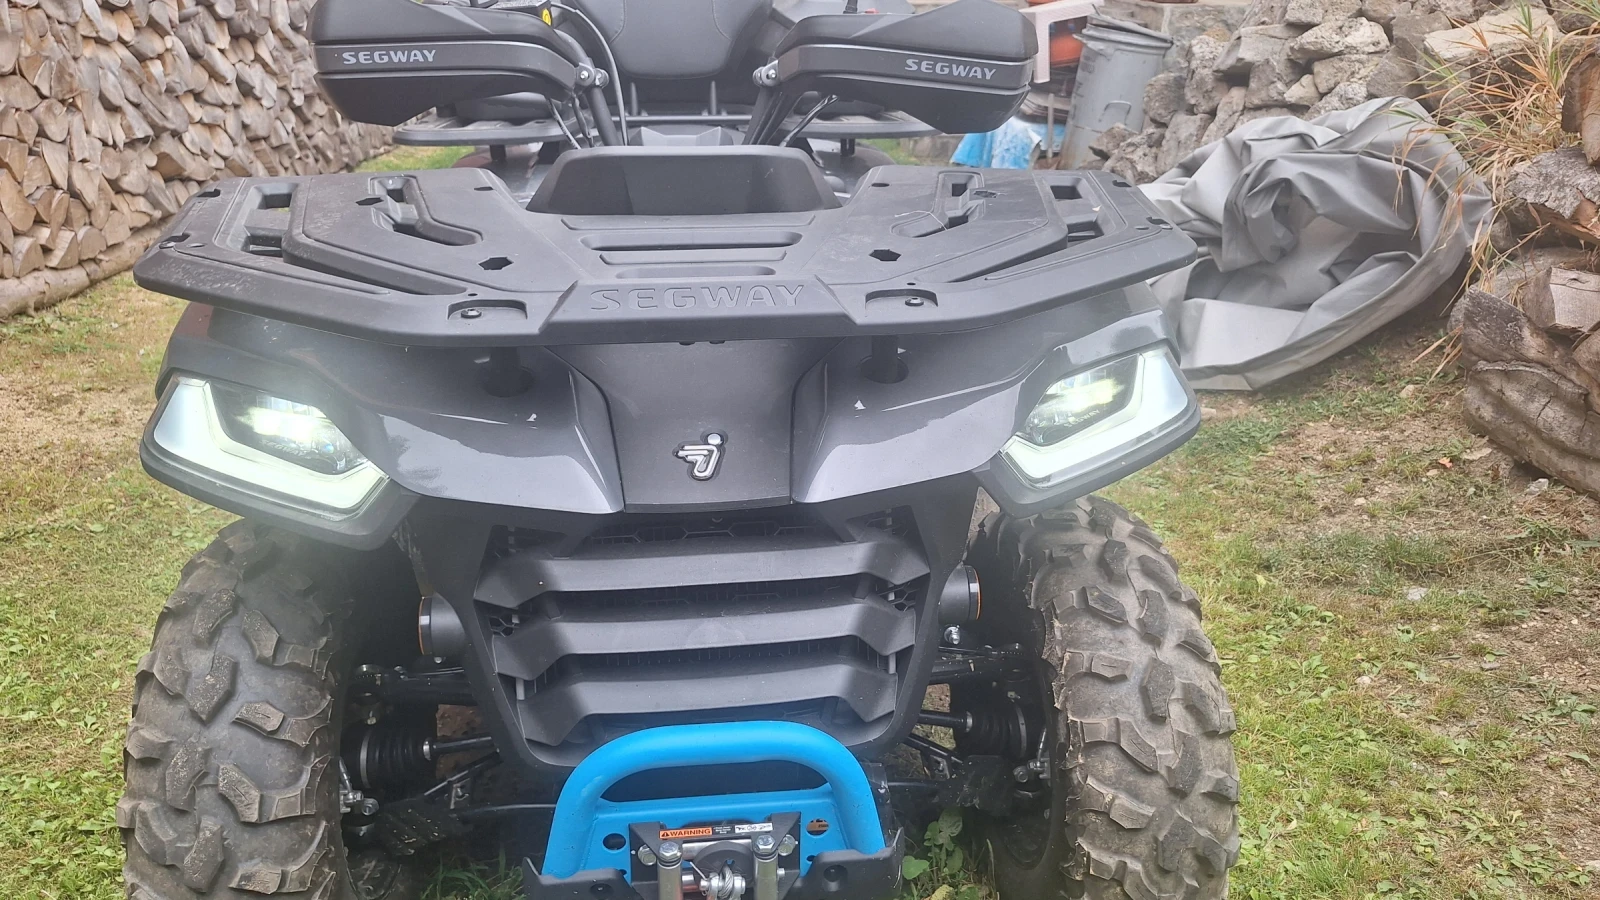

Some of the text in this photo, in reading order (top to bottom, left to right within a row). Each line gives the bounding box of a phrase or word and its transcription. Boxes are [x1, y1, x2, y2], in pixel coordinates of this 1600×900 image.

[341, 49, 437, 65] SEGWAY
[904, 58, 997, 80] SEGWAY
[590, 284, 804, 311] SEGWAY
[670, 828, 711, 837] WARNING
